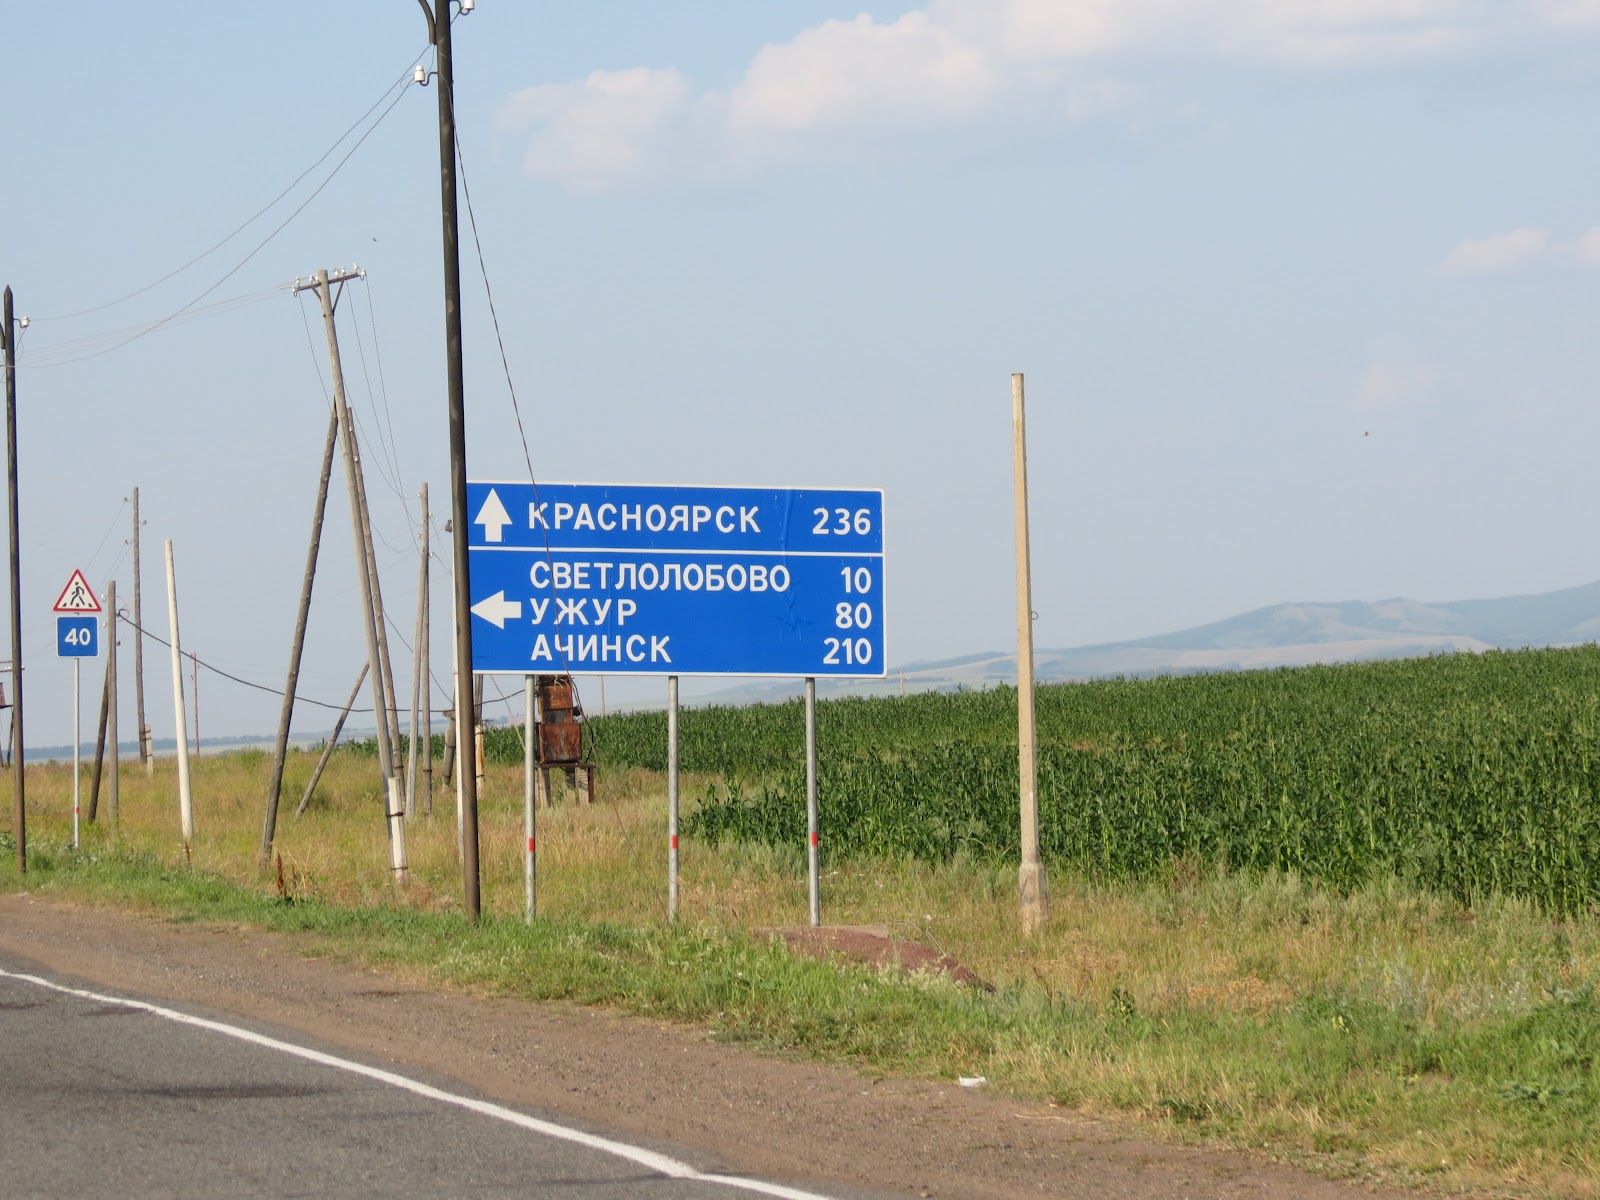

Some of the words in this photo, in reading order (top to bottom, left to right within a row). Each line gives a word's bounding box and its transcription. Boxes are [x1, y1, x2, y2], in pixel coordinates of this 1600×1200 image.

[529, 503, 760, 533] КРАСНОЯРСК
[813, 508, 870, 535] 236
[530, 561, 790, 592] СВЕТЛОЛОБОВО
[841, 567, 871, 593] 10
[530, 598, 636, 625] УЖУР
[836, 602, 872, 629] 80
[65, 628, 90, 645] 40
[531, 634, 671, 662] АЧИНСК
[823, 638, 872, 664] 210
